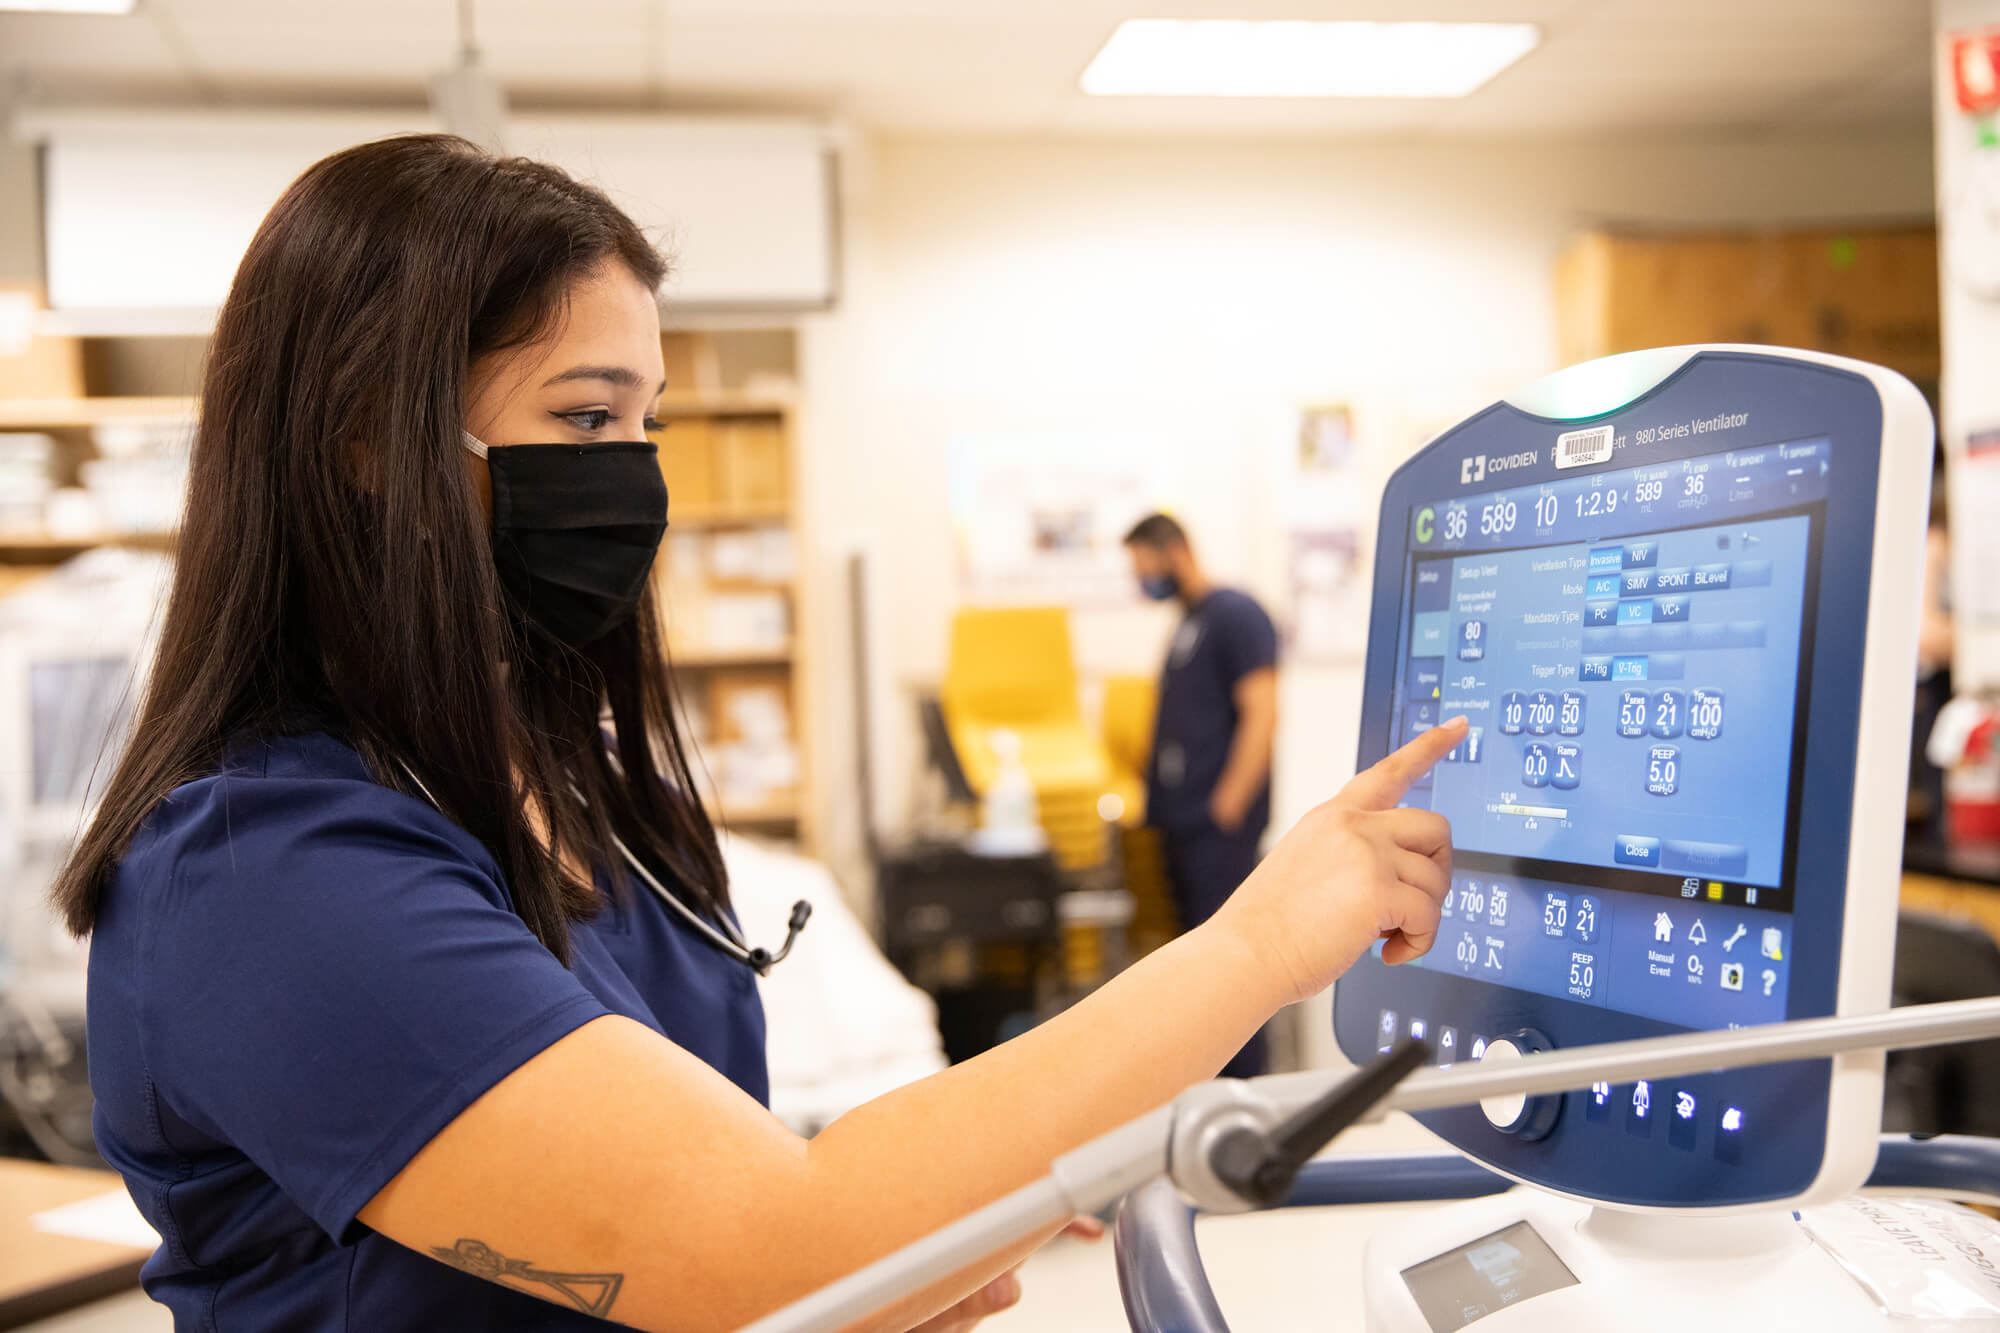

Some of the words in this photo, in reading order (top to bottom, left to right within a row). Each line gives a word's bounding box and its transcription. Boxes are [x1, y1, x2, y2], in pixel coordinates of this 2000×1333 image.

[1635, 428, 1656, 446] 980
[1657, 423, 1690, 442] Series
[1691, 413, 1750, 435] Ventilator
[1488, 451, 1538, 473] COVIDIEN
[1635, 481, 1662, 503] 589
[1684, 474, 1704, 496] 36
[1535, 496, 1558, 527] 10
[1575, 489, 1618, 517] 1:2.9
[1416, 507, 1435, 544] C
[1444, 510, 1467, 540] 36
[1480, 502, 1517, 535] 589
[1568, 557, 1587, 569] Type
[1590, 553, 1622, 566] Invasive
[1631, 549, 1648, 562] NIV
[1626, 577, 1649, 590] SIMV
[1657, 573, 1690, 587] SPONT
[1694, 570, 1728, 585] BiLevel
[1562, 584, 1584, 595] Mode
[1524, 612, 1560, 625] Mandatory
[1562, 611, 1580, 624] Type
[1594, 608, 1608, 620] PC
[1629, 606, 1641, 617] VC
[1661, 604, 1680, 616] VC+
[1465, 621, 1481, 640] 80
[1531, 664, 1556, 678] Trigger
[1557, 663, 1576, 678] Type
[1584, 663, 1608, 677] P-Trig
[1506, 704, 1522, 724] 10
[1528, 704, 1554, 724] 700
[1561, 704, 1580, 724] 50
[1621, 704, 1646, 725] 5.0
[1655, 703, 1677, 726] 21
[1690, 704, 1722, 727] 100
[1557, 745, 1578, 758] Ramp
[1651, 749, 1676, 760] PEEP
[1525, 755, 1547, 776] 0.0
[1649, 761, 1676, 783] 5.0
[1625, 844, 1649, 858] Close
[1460, 891, 1484, 914] 700
[1489, 896, 1507, 918] 50
[1544, 905, 1567, 927] 5.0
[1575, 910, 1595, 932] 21
[1546, 926, 1563, 937] L/min
[1457, 941, 1478, 964] 0.0
[1571, 952, 1594, 964] PEEP
[1648, 950, 1675, 964] Manual
[1650, 964, 1671, 977] Event
[1687, 955, 1704, 975] O2
[1569, 964, 1593, 987] 5.0
